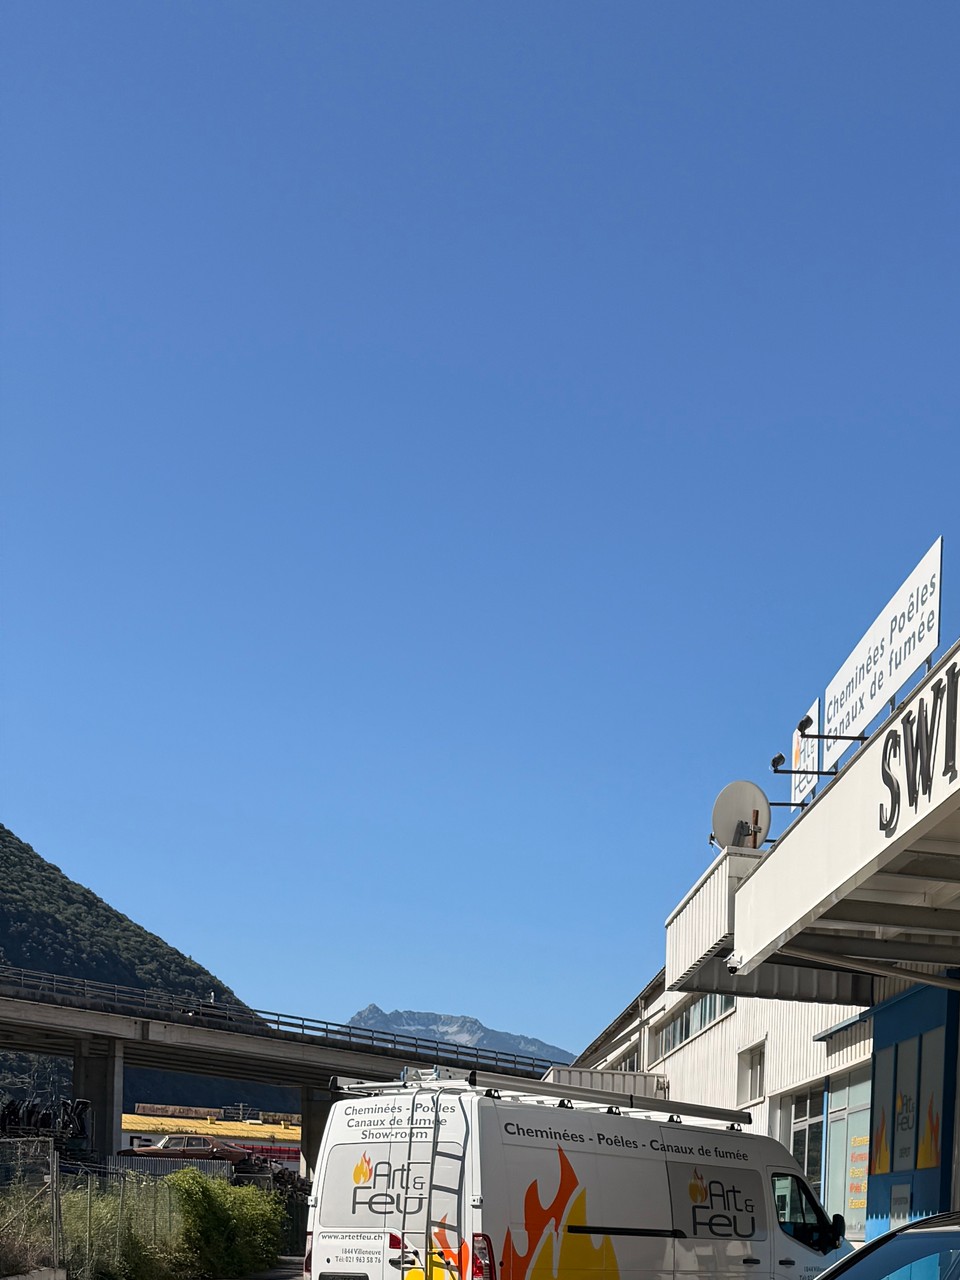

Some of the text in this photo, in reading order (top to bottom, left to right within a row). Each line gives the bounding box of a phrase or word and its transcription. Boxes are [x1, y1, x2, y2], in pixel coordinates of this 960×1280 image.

[826, 573, 936, 725] Cheminées Poêles
[825, 610, 935, 752] Canaux de fumée
[344, 1104, 403, 1116] Cheminées
[346, 1118, 385, 1128] Canaux
[389, 1116, 403, 1126] de
[361, 1129, 428, 1140] Show-room
[504, 1122, 585, 1143] Cheminées
[596, 1133, 639, 1149] Poêles
[649, 1140, 695, 1155] Canaux
[698, 1146, 712, 1157] de
[714, 1147, 749, 1160] fumée
[373, 1161, 411, 1189] Art
[352, 1186, 424, 1214] Feu
[709, 1181, 743, 1212] Art
[692, 1205, 755, 1238] Feu
